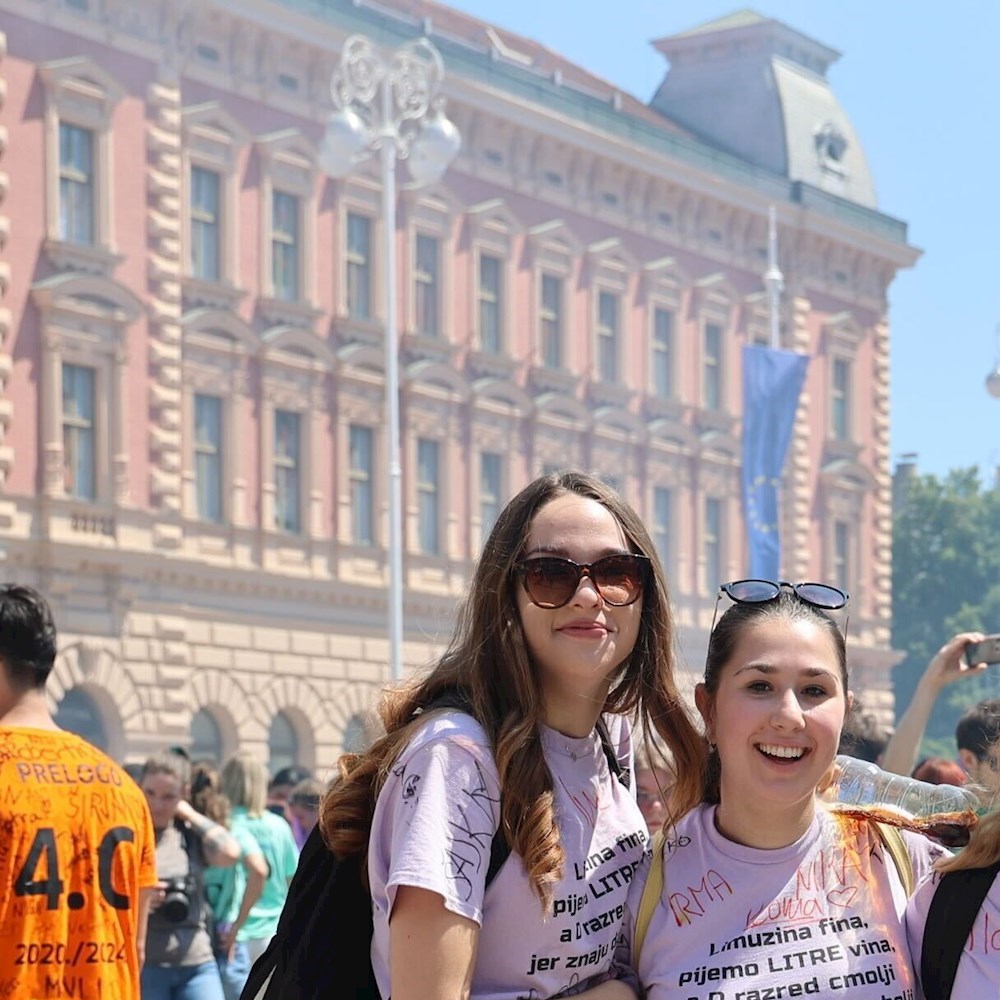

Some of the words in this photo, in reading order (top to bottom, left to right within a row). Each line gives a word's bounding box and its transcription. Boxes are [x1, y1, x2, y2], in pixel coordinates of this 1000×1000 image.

[14, 826, 135, 912] 4.C
[668, 868, 733, 928] IRMA
[583, 903, 627, 936] razre
[818, 915, 869, 937] fina,
[526, 954, 561, 976] jer
[565, 943, 609, 969] znaju
[678, 962, 760, 987] pijemo
[768, 944, 844, 974] LITRE
[849, 938, 897, 957] vina,
[829, 963, 896, 991] cmolji
